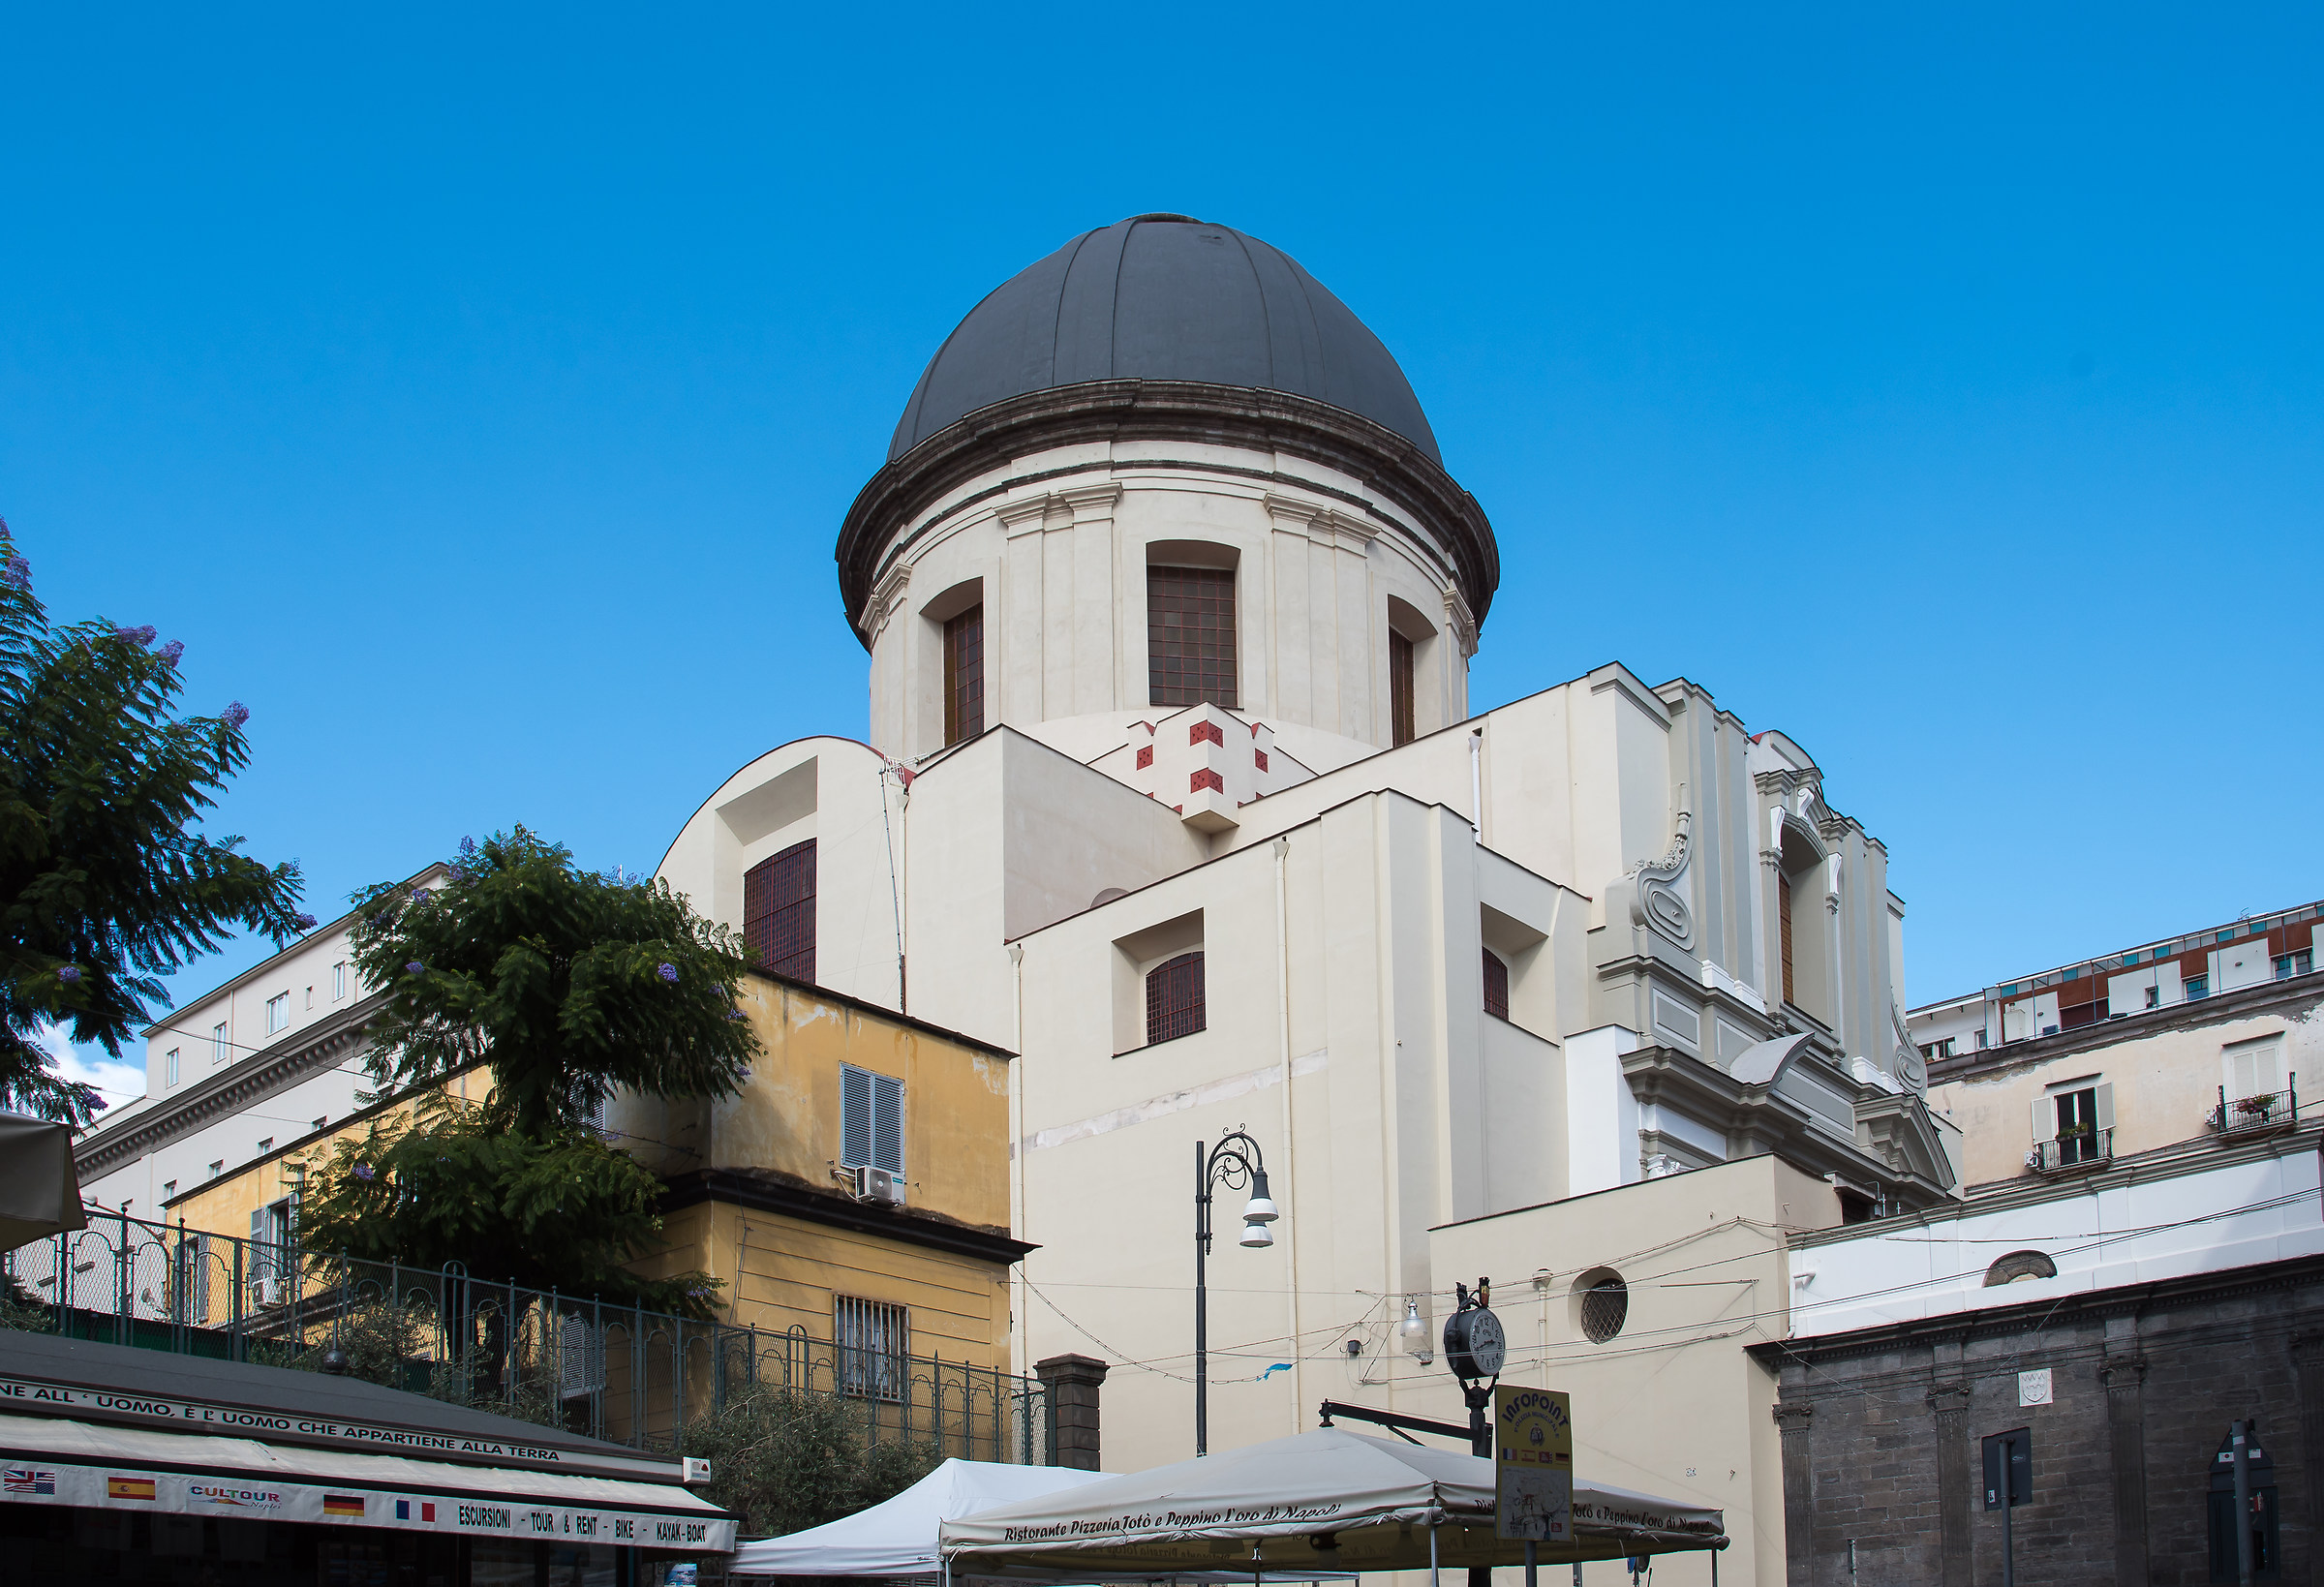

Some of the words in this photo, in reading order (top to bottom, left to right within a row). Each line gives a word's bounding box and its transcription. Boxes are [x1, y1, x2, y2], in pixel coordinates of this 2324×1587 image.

[97, 1395, 176, 1418] UOMO,
[221, 1412, 290, 1430] UOMO
[297, 1421, 338, 1436] CHE
[343, 1427, 456, 1450] APPARTIENE
[461, 1441, 504, 1455] ALLA
[508, 1446, 560, 1461] TERRA
[191, 1485, 281, 1503] CULTOUR
[458, 1505, 511, 1529] ESCURSIONI
[532, 1511, 555, 1533] TOUR
[564, 1514, 570, 1534] &
[576, 1515, 598, 1536] RENT
[615, 1519, 634, 1539] BIKE
[1004, 1522, 1067, 1542] Ristorante
[1070, 1516, 1120, 1536] Pizzeria
[1122, 1512, 1151, 1530] Totò
[1155, 1515, 1162, 1527] e
[1165, 1510, 1222, 1529] Peppino
[1263, 1506, 1279, 1520] di
[1280, 1503, 1342, 1522] Napoli
[1604, 1506, 1639, 1526] Peppino
[1667, 1514, 1676, 1530] di
